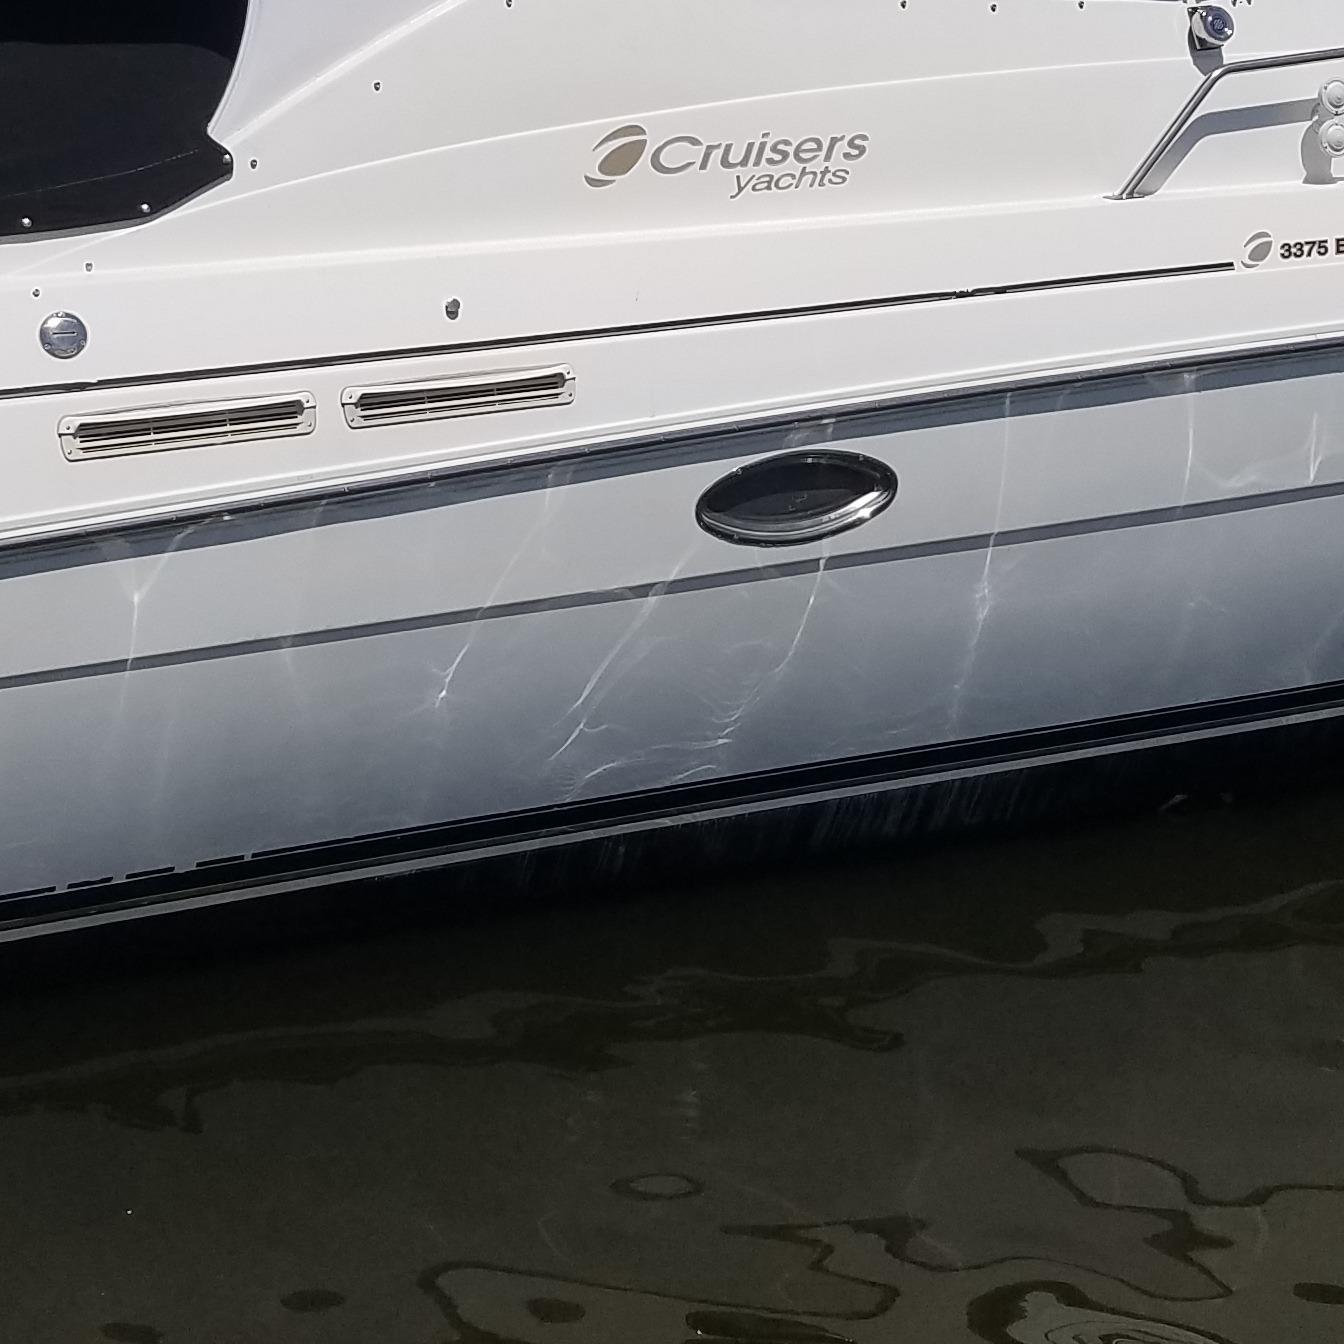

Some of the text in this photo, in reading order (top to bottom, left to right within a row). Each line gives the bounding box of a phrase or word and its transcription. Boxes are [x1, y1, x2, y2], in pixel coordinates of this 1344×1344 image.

[651, 132, 869, 175] Cruisers
[730, 166, 850, 199] yachts
[1279, 239, 1329, 259] 3375
